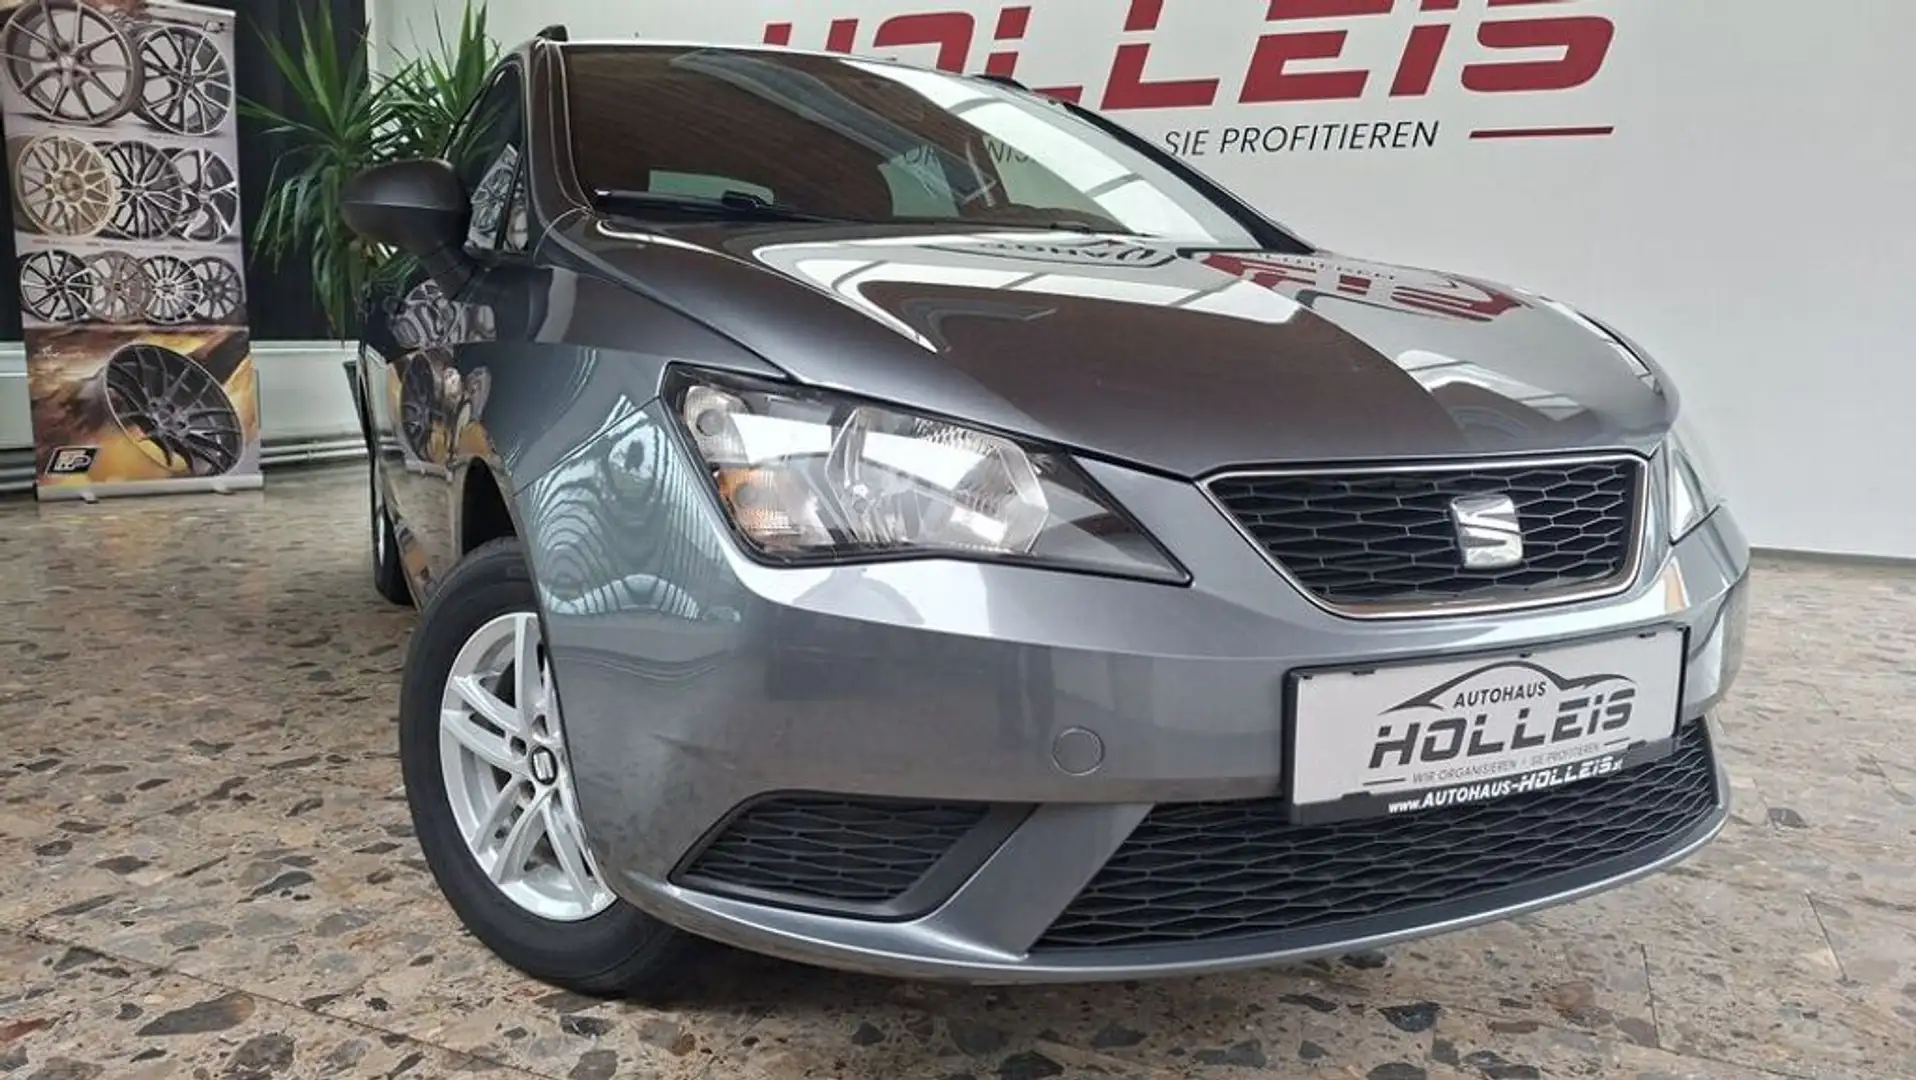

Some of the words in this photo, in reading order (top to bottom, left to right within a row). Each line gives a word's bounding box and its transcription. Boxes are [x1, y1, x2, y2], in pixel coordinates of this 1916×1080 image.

[1165, 130, 1209, 156] SIE
[1219, 120, 1439, 154] PROFITIEREN
[1454, 681, 1547, 708] AUTOHAUS
[1368, 688, 1635, 769] HOLLEIS
[1412, 770, 1439, 783] WIR
